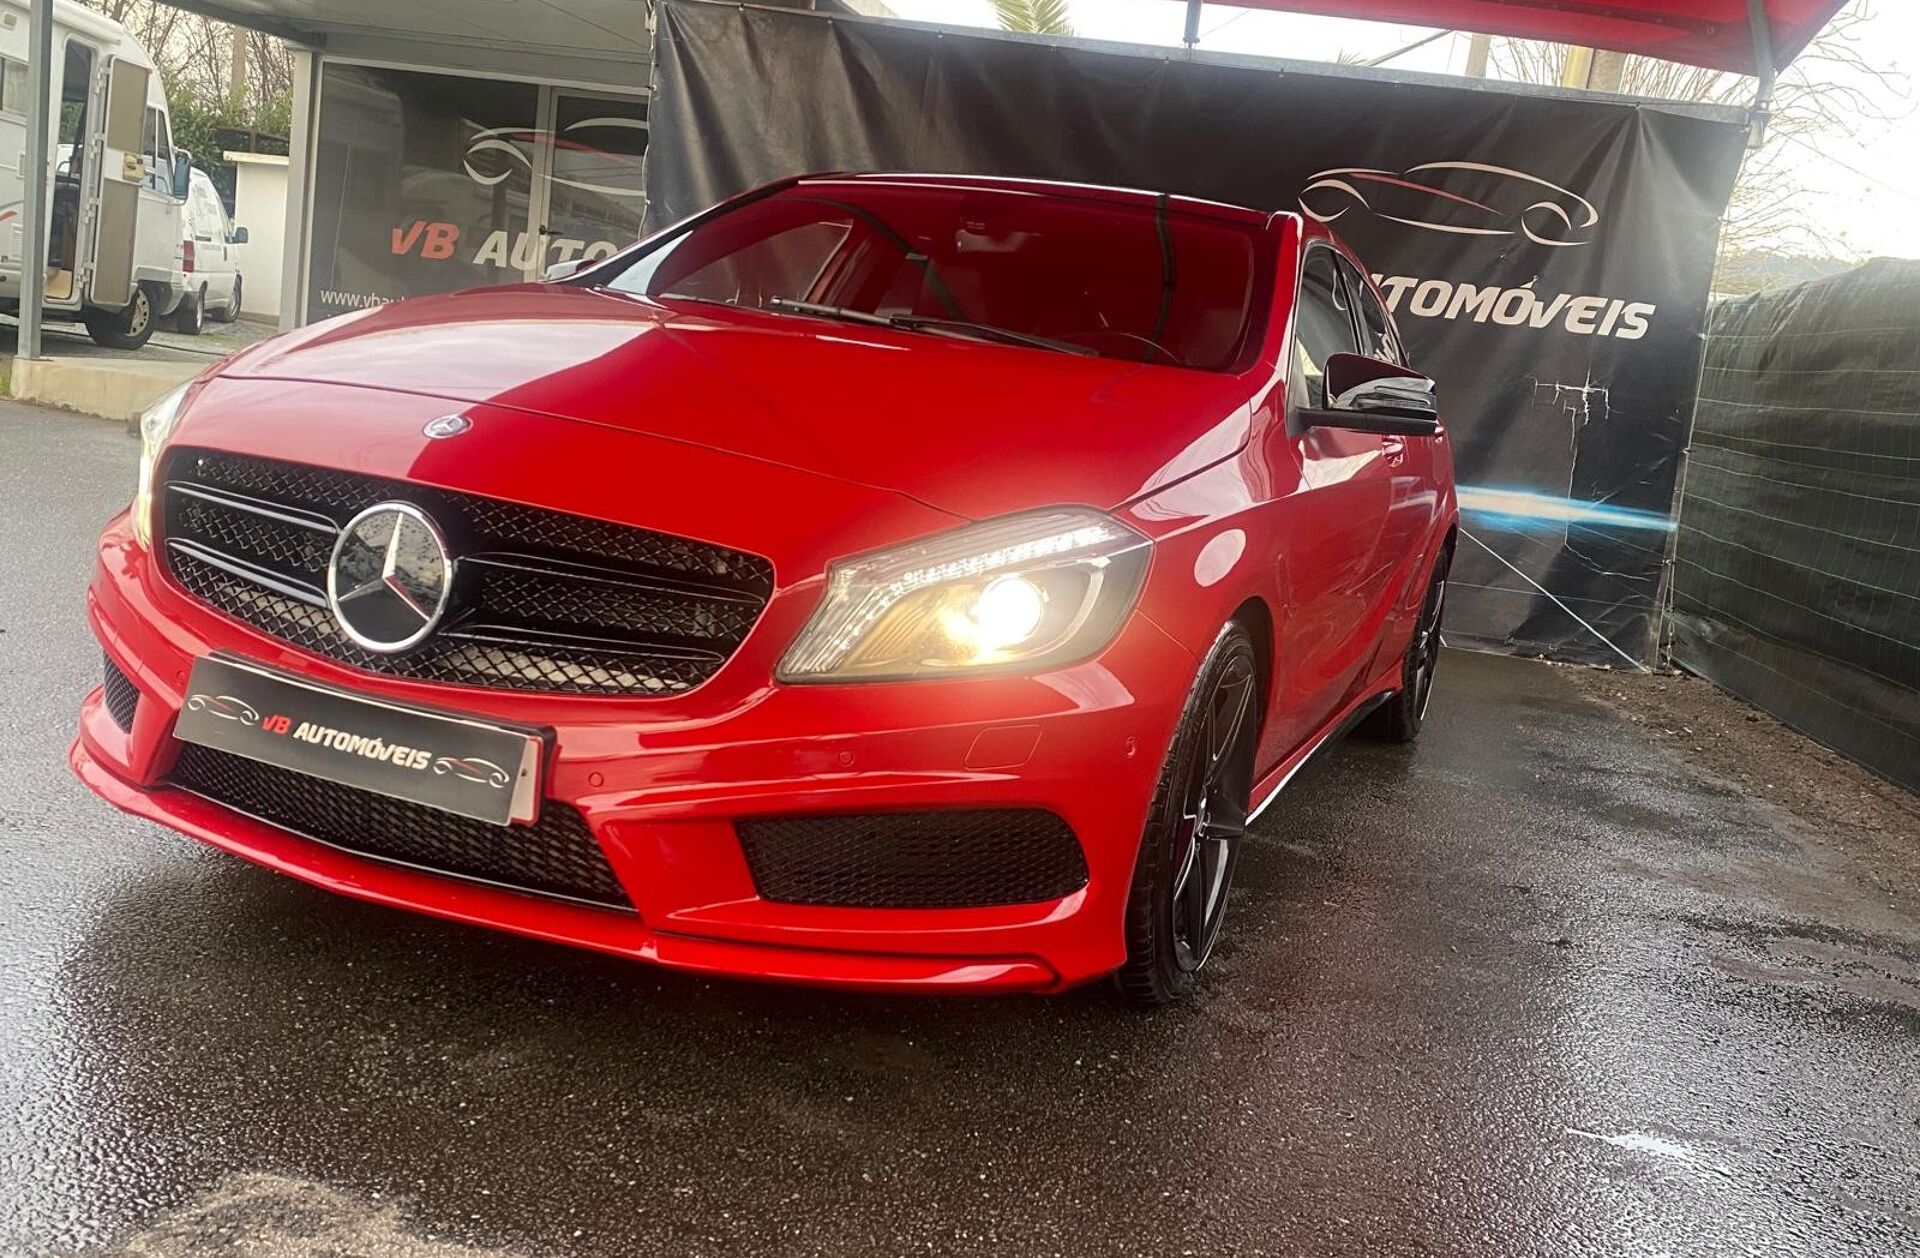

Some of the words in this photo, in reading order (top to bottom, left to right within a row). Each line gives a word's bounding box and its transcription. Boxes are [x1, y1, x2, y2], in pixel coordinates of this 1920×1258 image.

[391, 221, 460, 260] VB
[1370, 273, 1656, 340] TOMÓVEIS
[262, 714, 291, 735] VB
[293, 722, 432, 770] AUTOMÓVEIS
